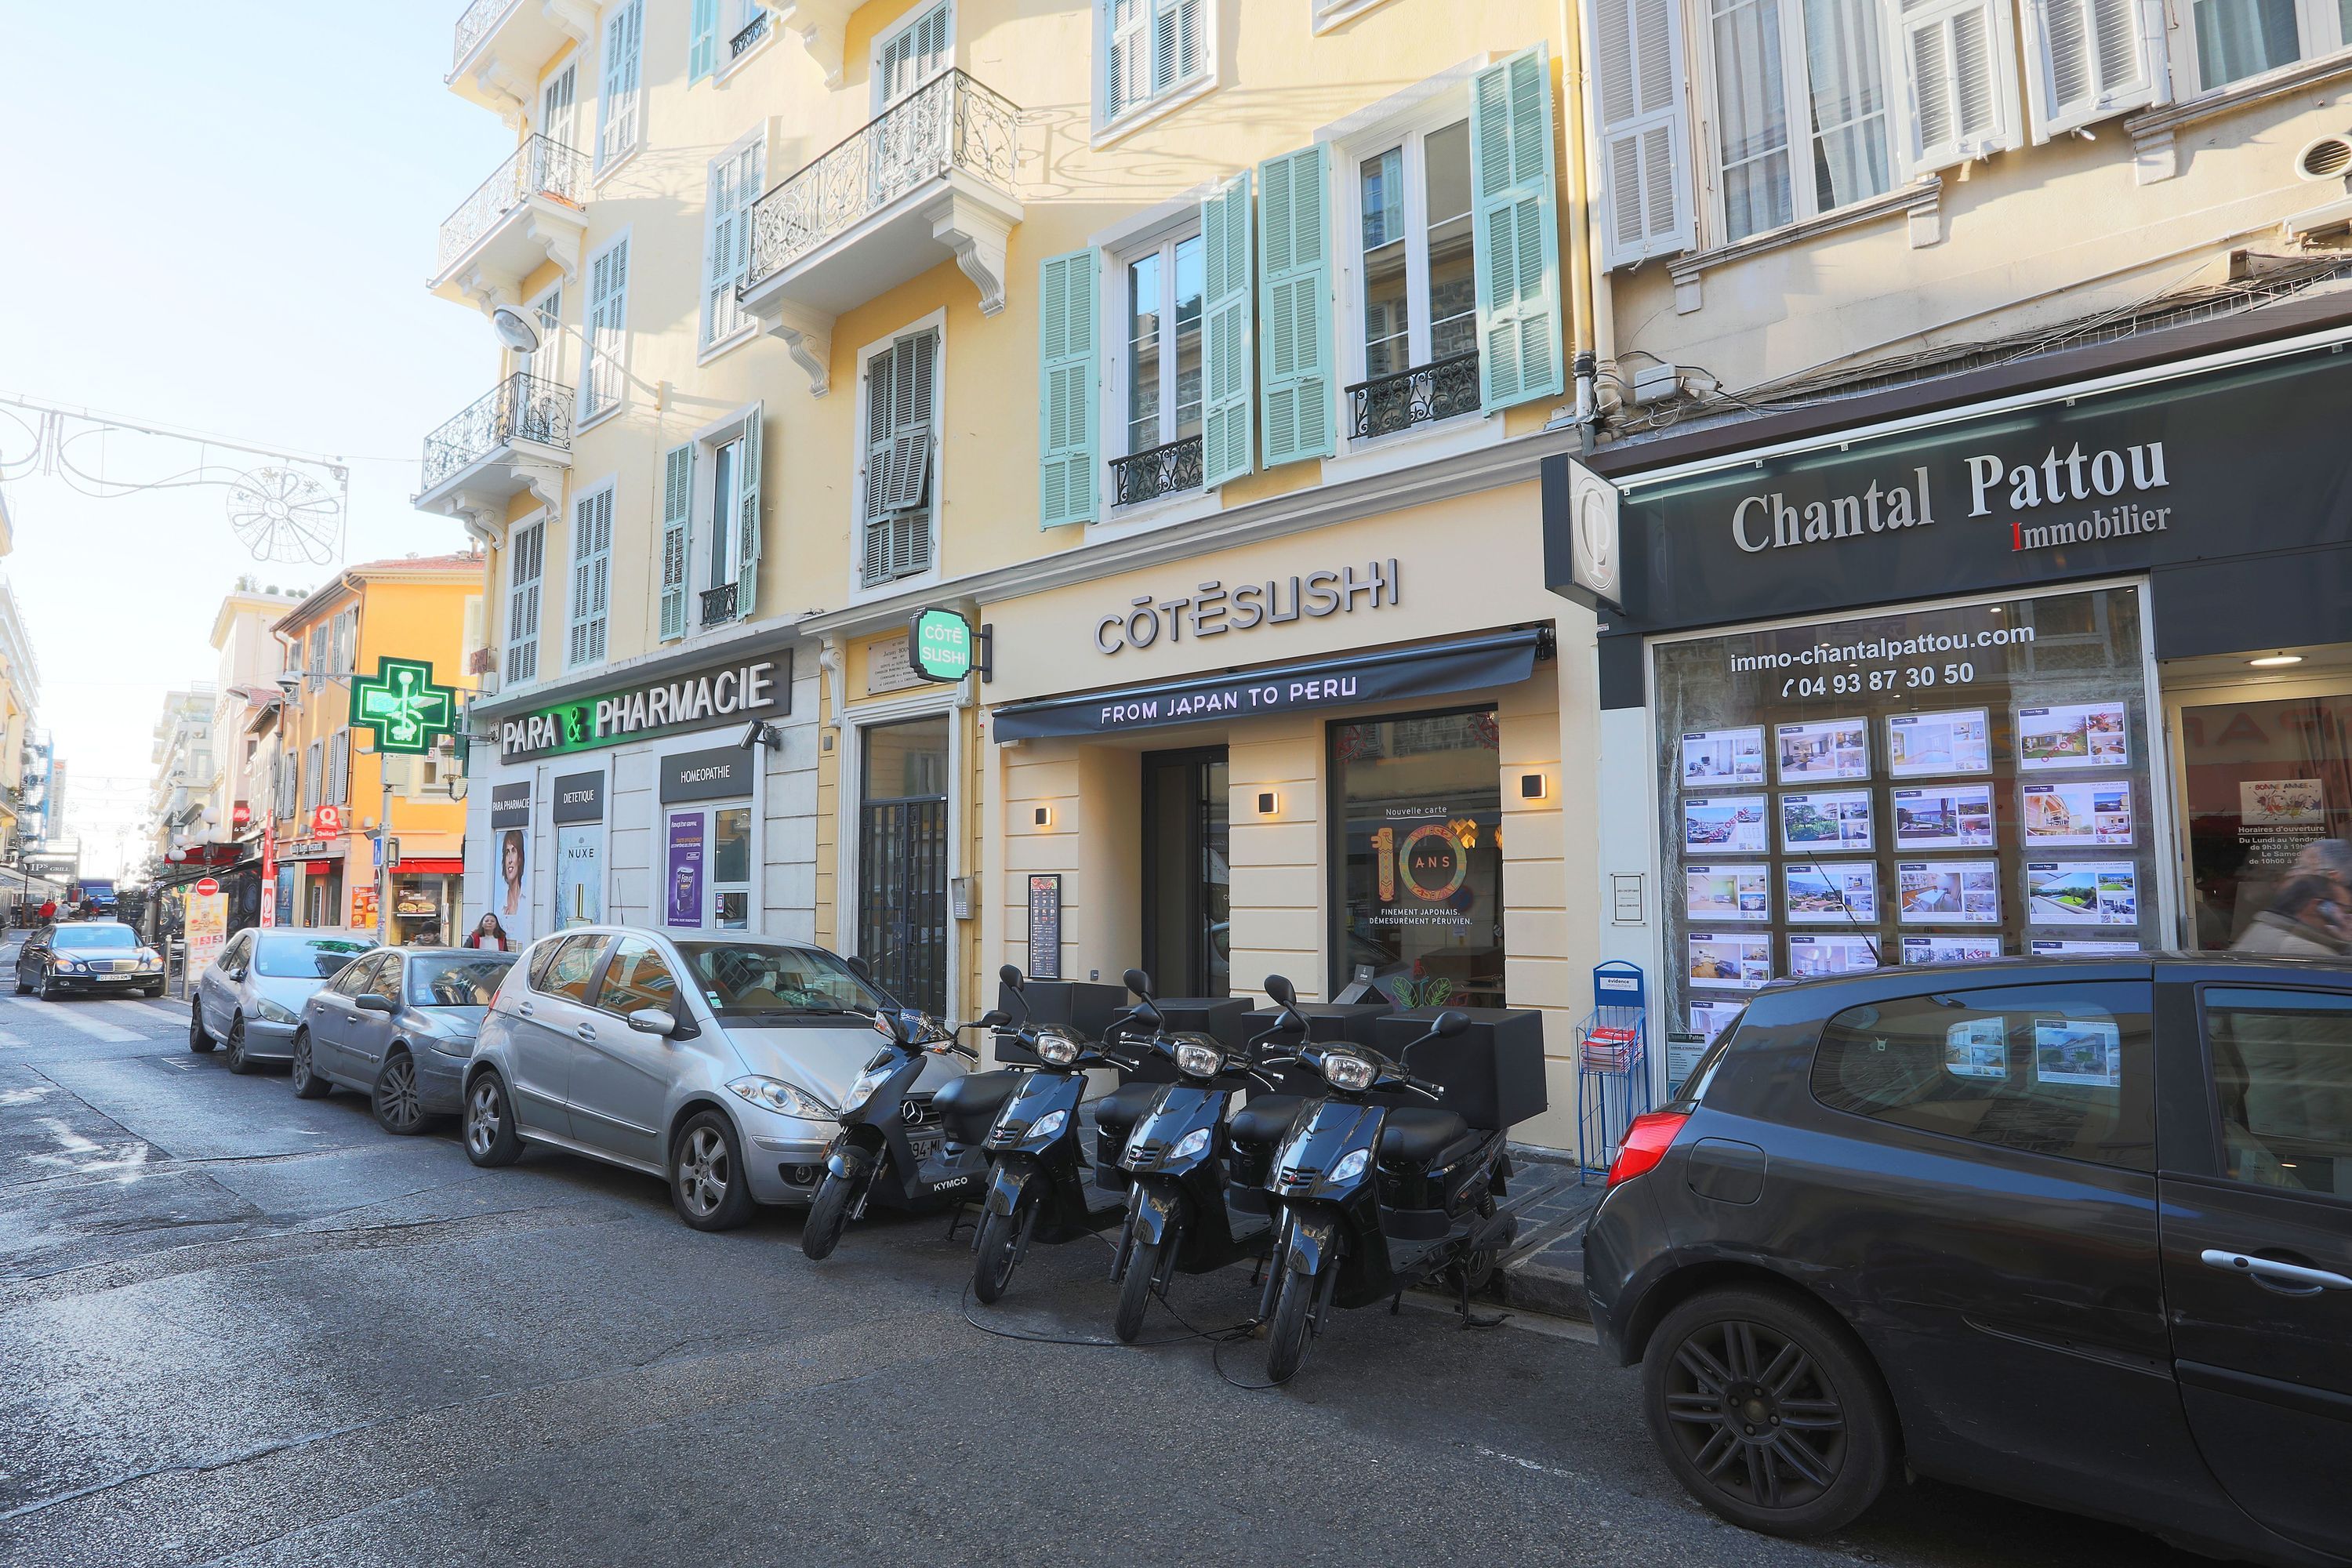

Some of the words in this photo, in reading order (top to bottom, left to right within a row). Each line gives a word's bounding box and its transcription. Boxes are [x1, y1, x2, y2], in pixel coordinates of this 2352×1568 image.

[1732, 466, 1935, 553] Chantal
[1965, 441, 2169, 517] Pattou
[2011, 505, 2171, 553] Immobilier
[921, 646, 965, 666] SUSHI
[1730, 626, 2034, 672] immo-chantalpattou.com
[1798, 677, 1826, 697] 04
[1833, 673, 1861, 694] 93
[1868, 670, 1897, 691] 87
[1906, 666, 1935, 688] 30
[1944, 662, 1974, 684] 50
[503, 713, 558, 755] PARA
[566, 706, 585, 742] &
[595, 662, 775, 738] PHARMACIE
[1101, 701, 1157, 724] FROM
[1167, 691, 1239, 717] JAPAN
[1248, 686, 1278, 706] TO
[1290, 677, 1357, 702] PERU
[681, 764, 731, 784] HOMEOPATHIE
[492, 800, 503, 811] PARA
[503, 797, 530, 811] PHARMACIE
[563, 789, 594, 804] DIETETIQUE
[234, 809, 249, 820] illy
[1385, 807, 1421, 816] Nouvelle
[568, 848, 594, 859] NUXE
[1370, 824, 1468, 902] 10
[1415, 856, 1450, 868] ANS
[1369, 916, 1429, 925] DÉMESURÉMENT
[1432, 916, 1472, 925] PÉRUVIEN.
[933, 1176, 968, 1192] KYMCO
